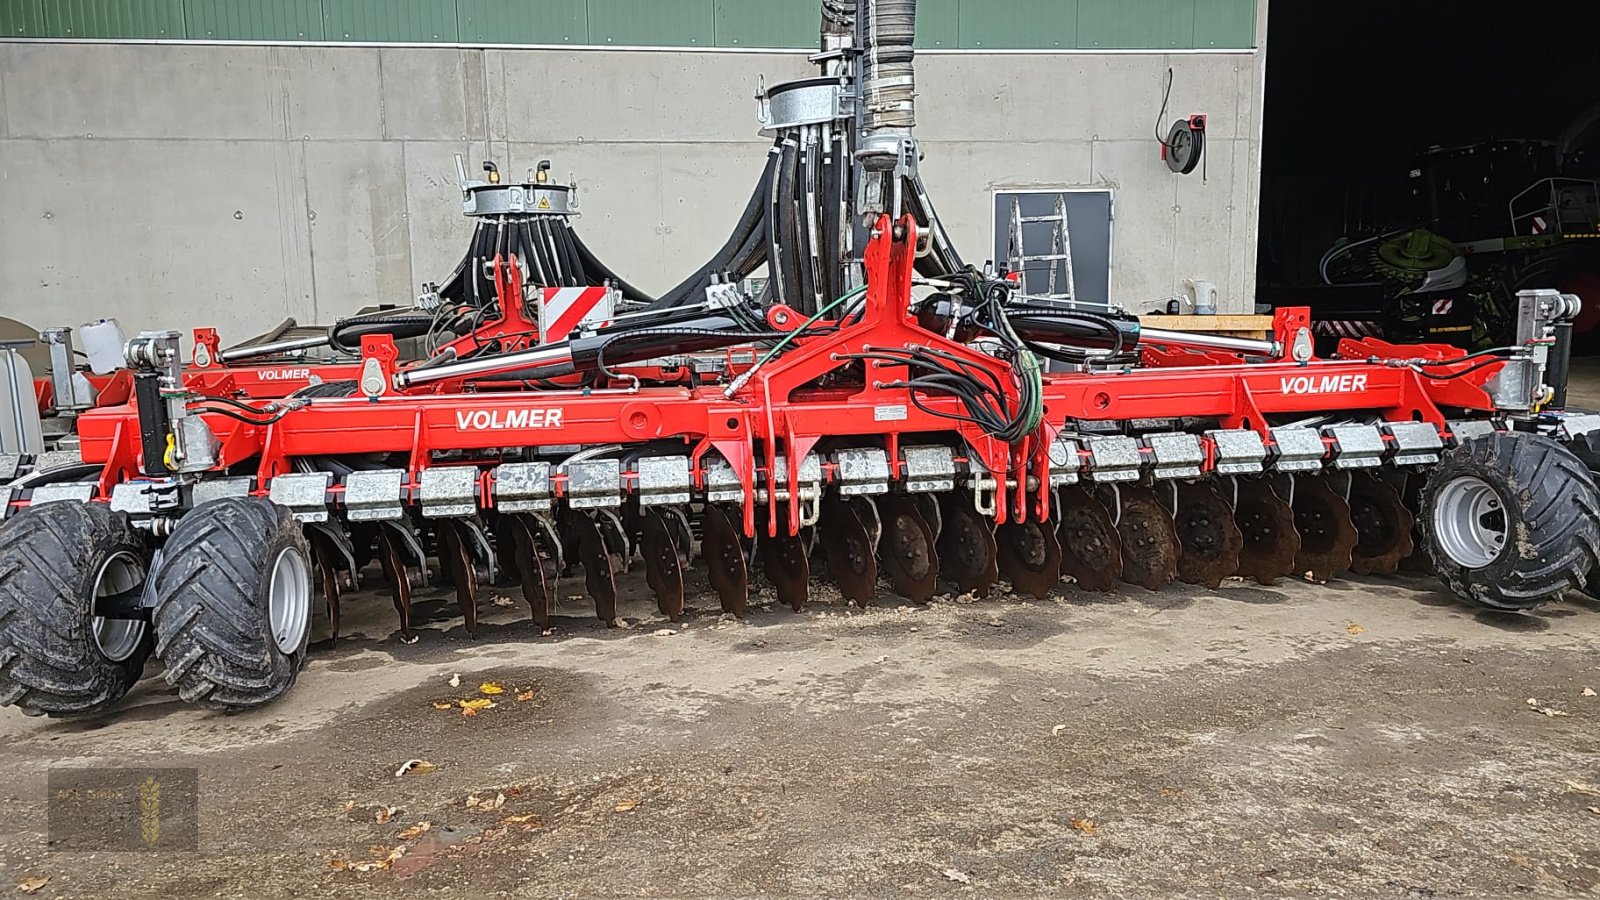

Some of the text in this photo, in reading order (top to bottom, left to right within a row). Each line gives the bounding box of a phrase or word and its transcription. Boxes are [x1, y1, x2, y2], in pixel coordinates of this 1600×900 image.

[257, 368, 310, 380] VOLMER
[1280, 374, 1367, 394] VOLMER
[456, 408, 563, 430] VOLMER
